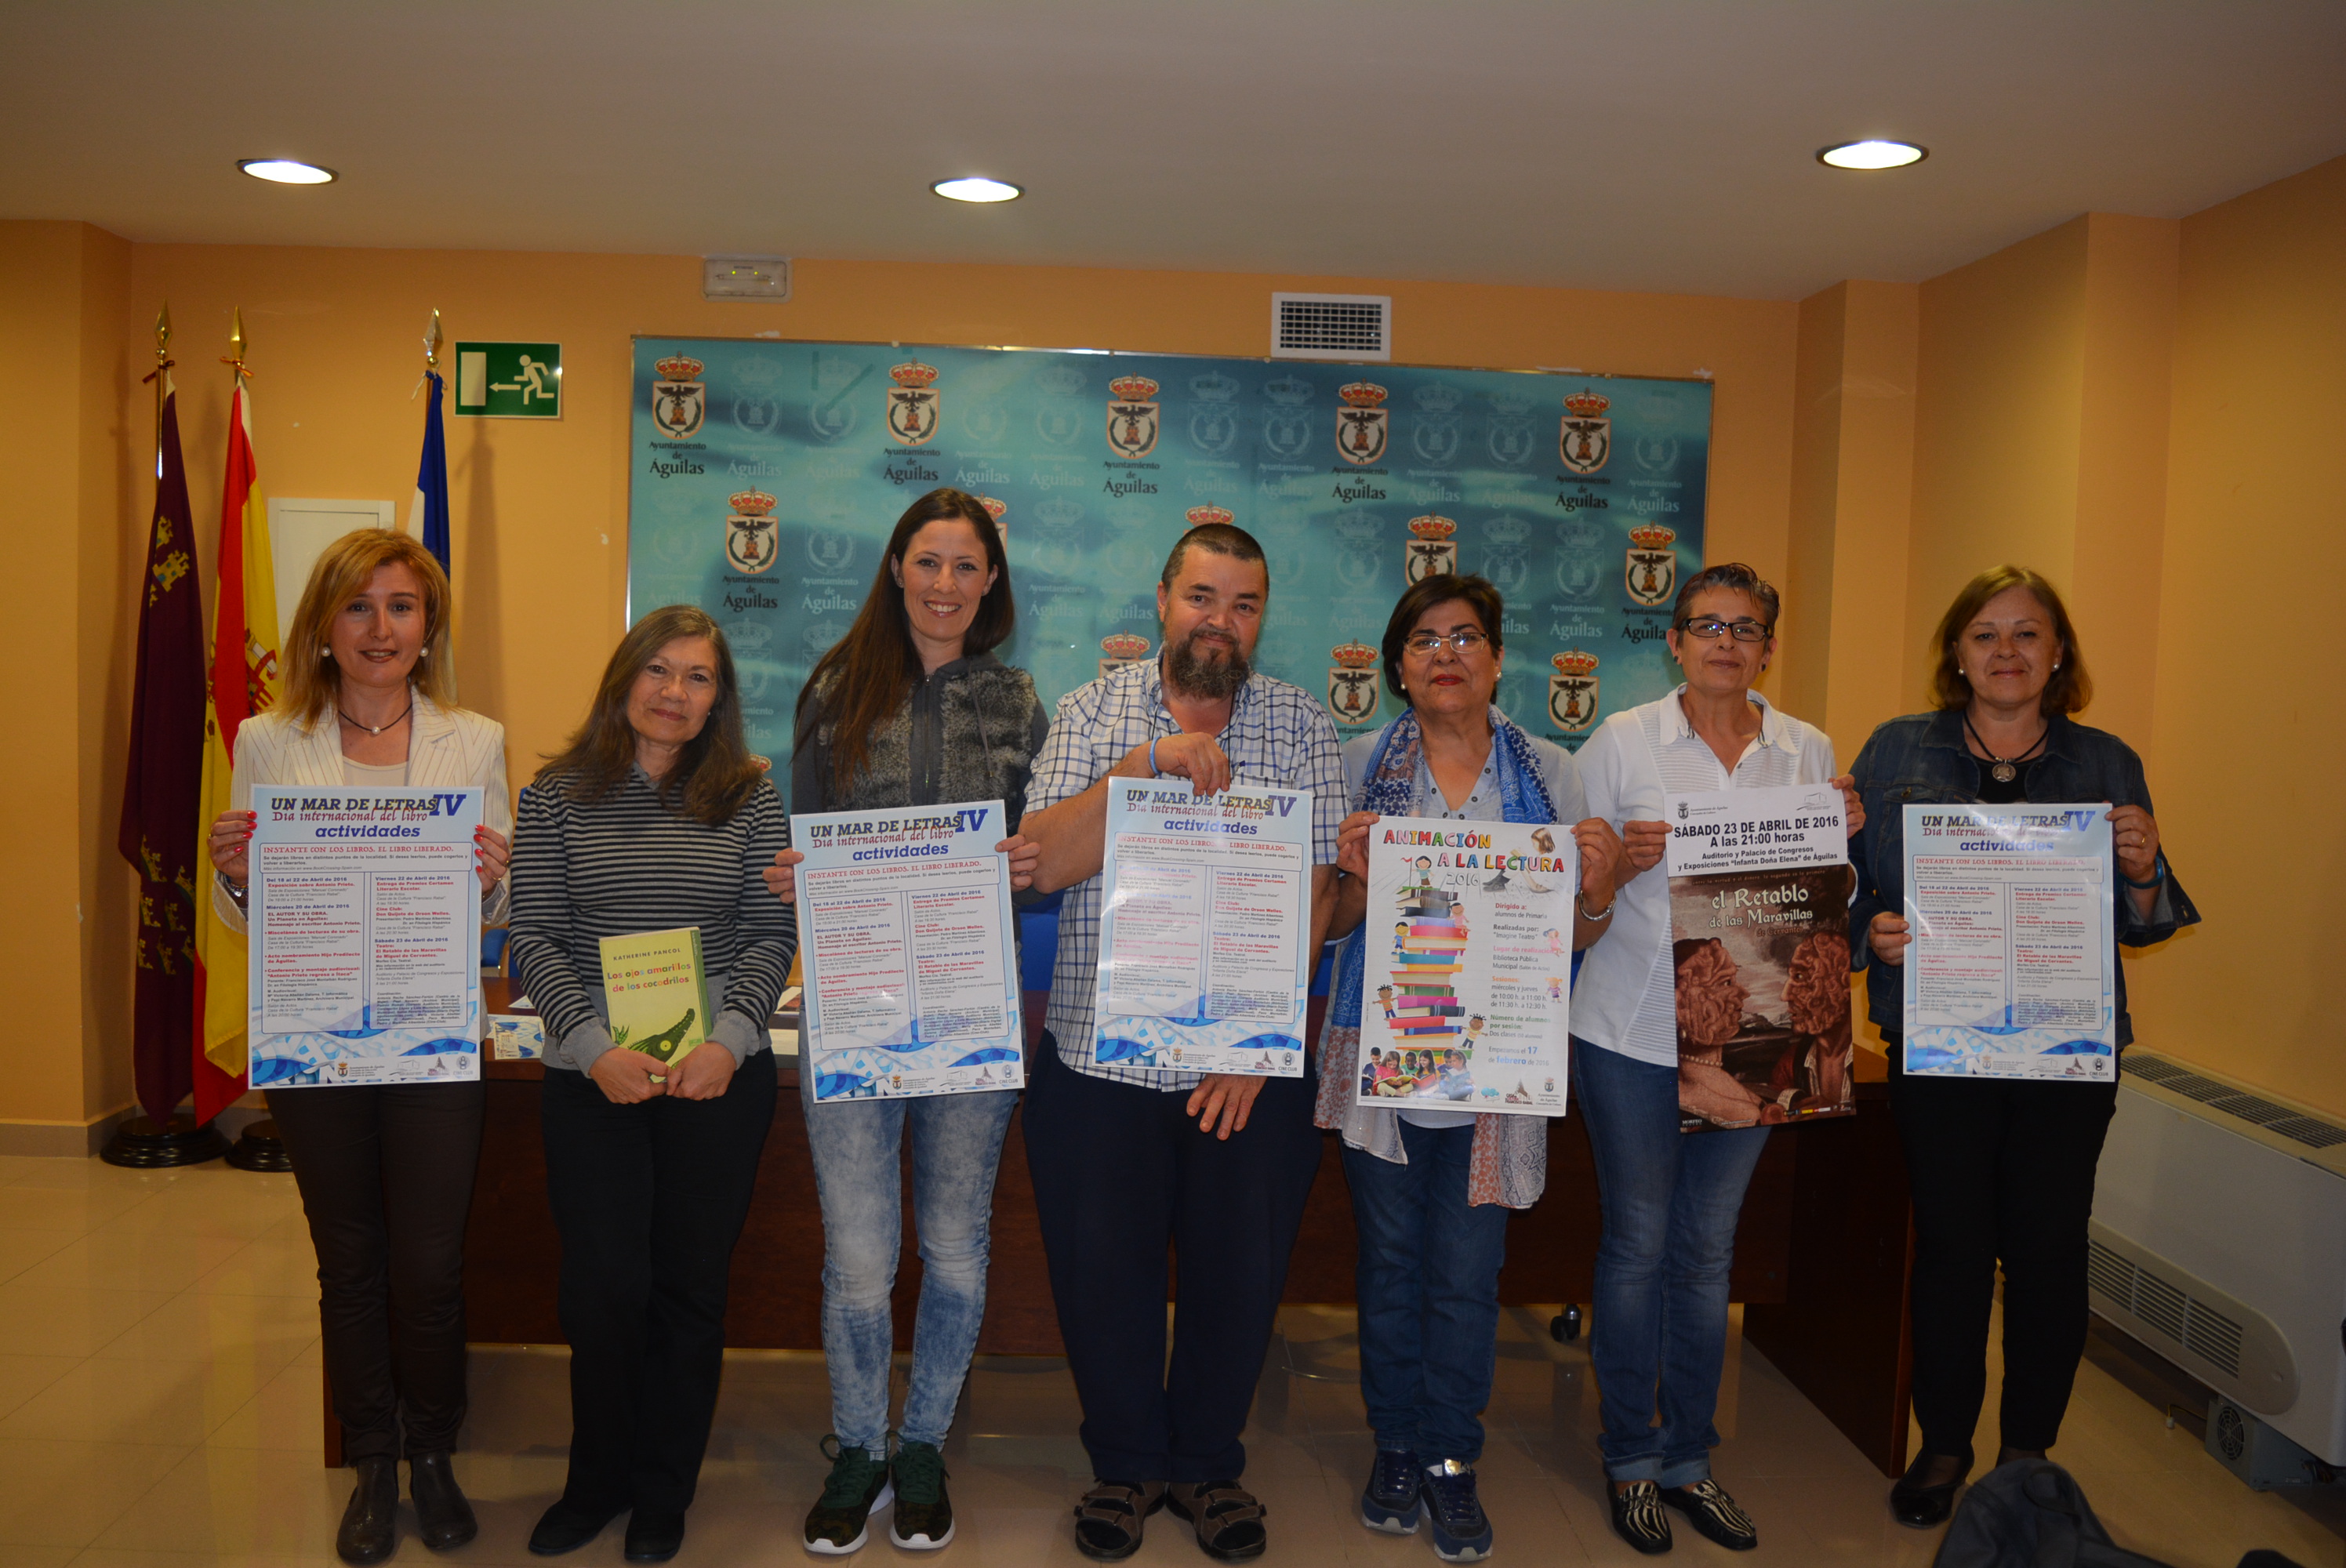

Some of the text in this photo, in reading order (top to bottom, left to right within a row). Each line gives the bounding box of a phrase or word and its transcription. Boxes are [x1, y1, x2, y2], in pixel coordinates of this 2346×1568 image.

[649, 441, 706, 451] Ayuntamiento
[884, 448, 941, 457] Ayuntamiento
[672, 451, 682, 459] de
[906, 457, 916, 466] de
[649, 459, 705, 479] Águilas
[1102, 461, 1160, 470] Ayuntamiento
[1332, 466, 1389, 476] Ayuntamiento
[884, 466, 939, 485] Águilas
[1126, 470, 1136, 479] de
[1355, 476, 1364, 485] de
[1556, 475, 1611, 485] Ayuntamiento
[1102, 477, 1158, 498] Águilas
[1332, 483, 1386, 503] Águilas
[1578, 485, 1588, 494] de
[1555, 492, 1609, 512] Águilas
[1627, 495, 1680, 516] Águilas
[722, 575, 779, 585] Ayuntamiento
[746, 585, 756, 593] de
[723, 592, 778, 612] Águilas
[801, 593, 857, 615] Águilas
[1643, 617, 1653, 626] de
[1621, 623, 1667, 644] Águila
[271, 793, 467, 816] UN MAR DE LETRAS IV
[1127, 789, 1297, 818] UN MAR DE LETRAS IV
[1151, 801, 1219, 817] internacional
[1222, 805, 1237, 818] del
[1240, 806, 1263, 820] libro
[300, 807, 375, 822] internacional
[380, 808, 397, 821] del
[401, 807, 427, 821] libro
[810, 808, 989, 838] UN MAR DE LETRAS IV
[1922, 815, 1943, 827] UN
[1947, 815, 1985, 827] MAR
[2062, 811, 2096, 832] IV
[314, 825, 421, 838] actividades
[1164, 818, 1258, 835] actividades
[1674, 815, 1839, 838] SÁBADO 23 DE ABRIL DE 2016
[837, 829, 906, 846] internacional
[910, 828, 925, 841] del
[929, 826, 954, 840] libro
[1383, 829, 1491, 848] ANIMACIÓN
[1710, 832, 1804, 848] A las 21:00 horas
[852, 844, 949, 861] actividades
[1702, 851, 1734, 860] Auditorio
[1778, 847, 1814, 855] Congresos
[1959, 840, 2054, 852] actividades
[1437, 852, 1564, 873] A LA LECTURA
[1684, 860, 1730, 870] Exposiciones
[1813, 852, 1838, 862] Águilas
[1446, 873, 1481, 886] 2016
[1711, 884, 1809, 909] el Retablo
[1709, 908, 1813, 929] de las Maravillas
[613, 952, 651, 960] KATHERINE
[626, 969, 645, 978] ojos
[647, 963, 691, 975] amarillos
[612, 984, 624, 993] de
[643, 976, 689, 988] cocodrilos
[1496, 1055, 1527, 1065] febrero
